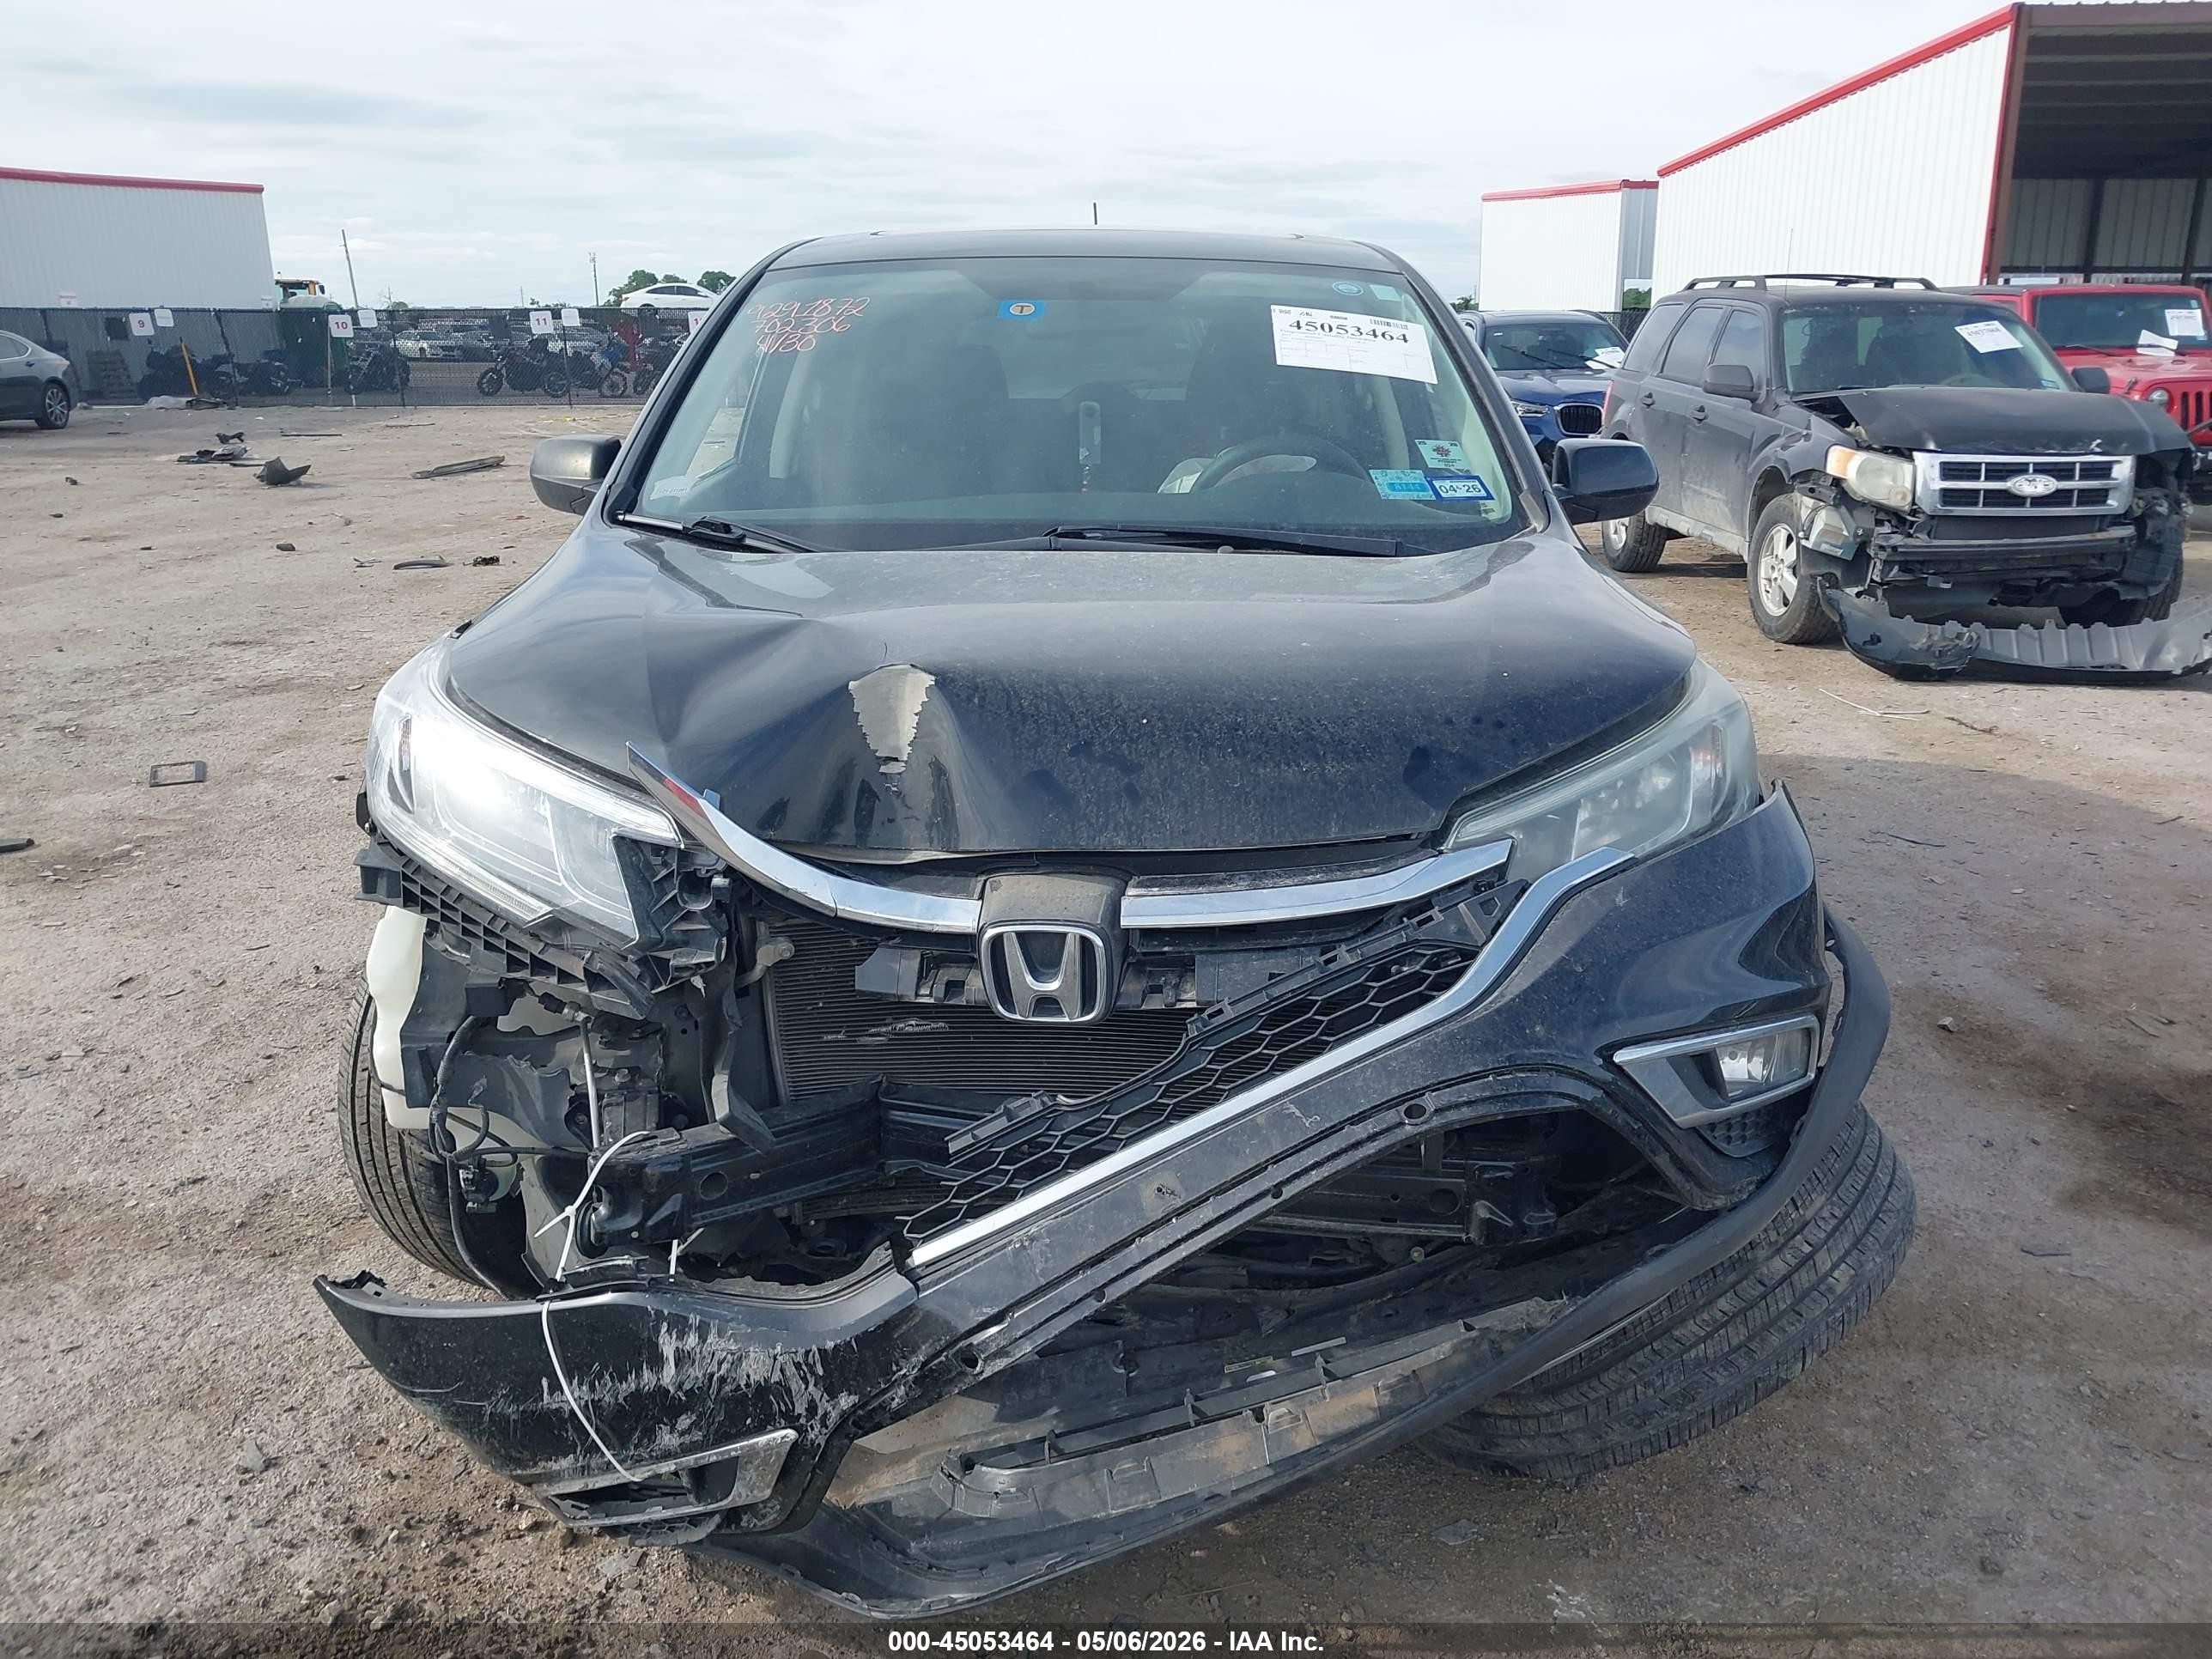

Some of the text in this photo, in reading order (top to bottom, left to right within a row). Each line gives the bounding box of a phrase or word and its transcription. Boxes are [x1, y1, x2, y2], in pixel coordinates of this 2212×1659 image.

[137, 319, 145, 328] 9
[334, 320, 349, 330] 10
[535, 317, 548, 326] 11
[1289, 319, 1409, 343] 45053464
